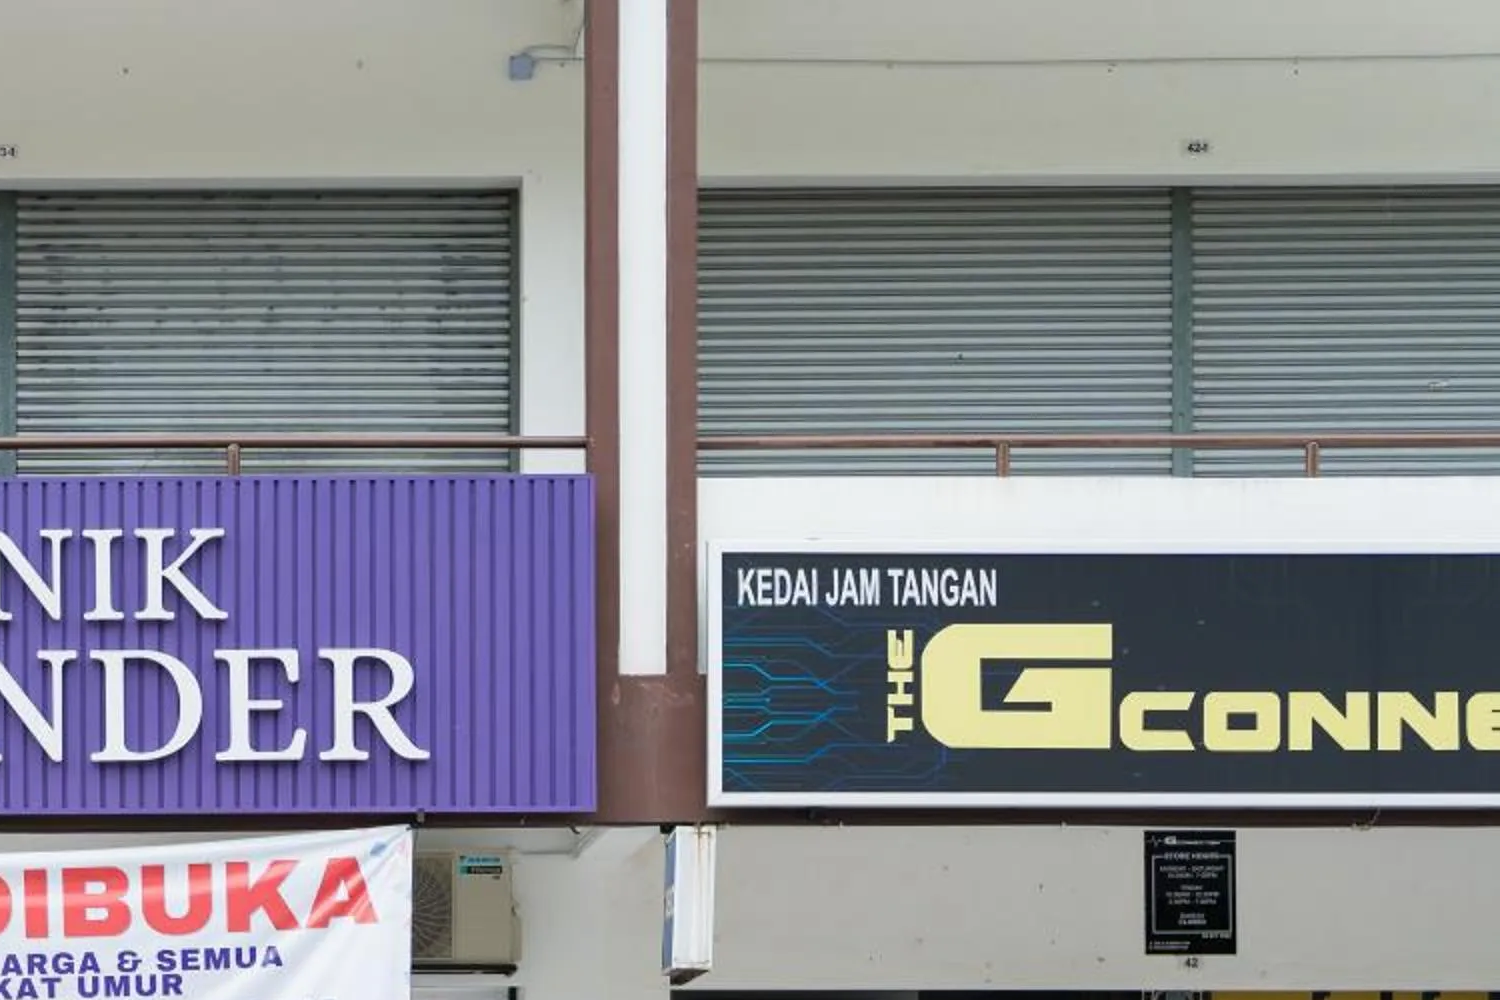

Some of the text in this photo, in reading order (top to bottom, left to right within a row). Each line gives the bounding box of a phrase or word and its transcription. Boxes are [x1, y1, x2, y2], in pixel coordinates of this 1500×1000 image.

[737, 568, 997, 607] KEDAI JAM TANGAN
[887, 629, 913, 743] THE
[117, 950, 142, 973] &
[157, 946, 283, 972] SEMUA
[77, 973, 184, 999] UMUR
